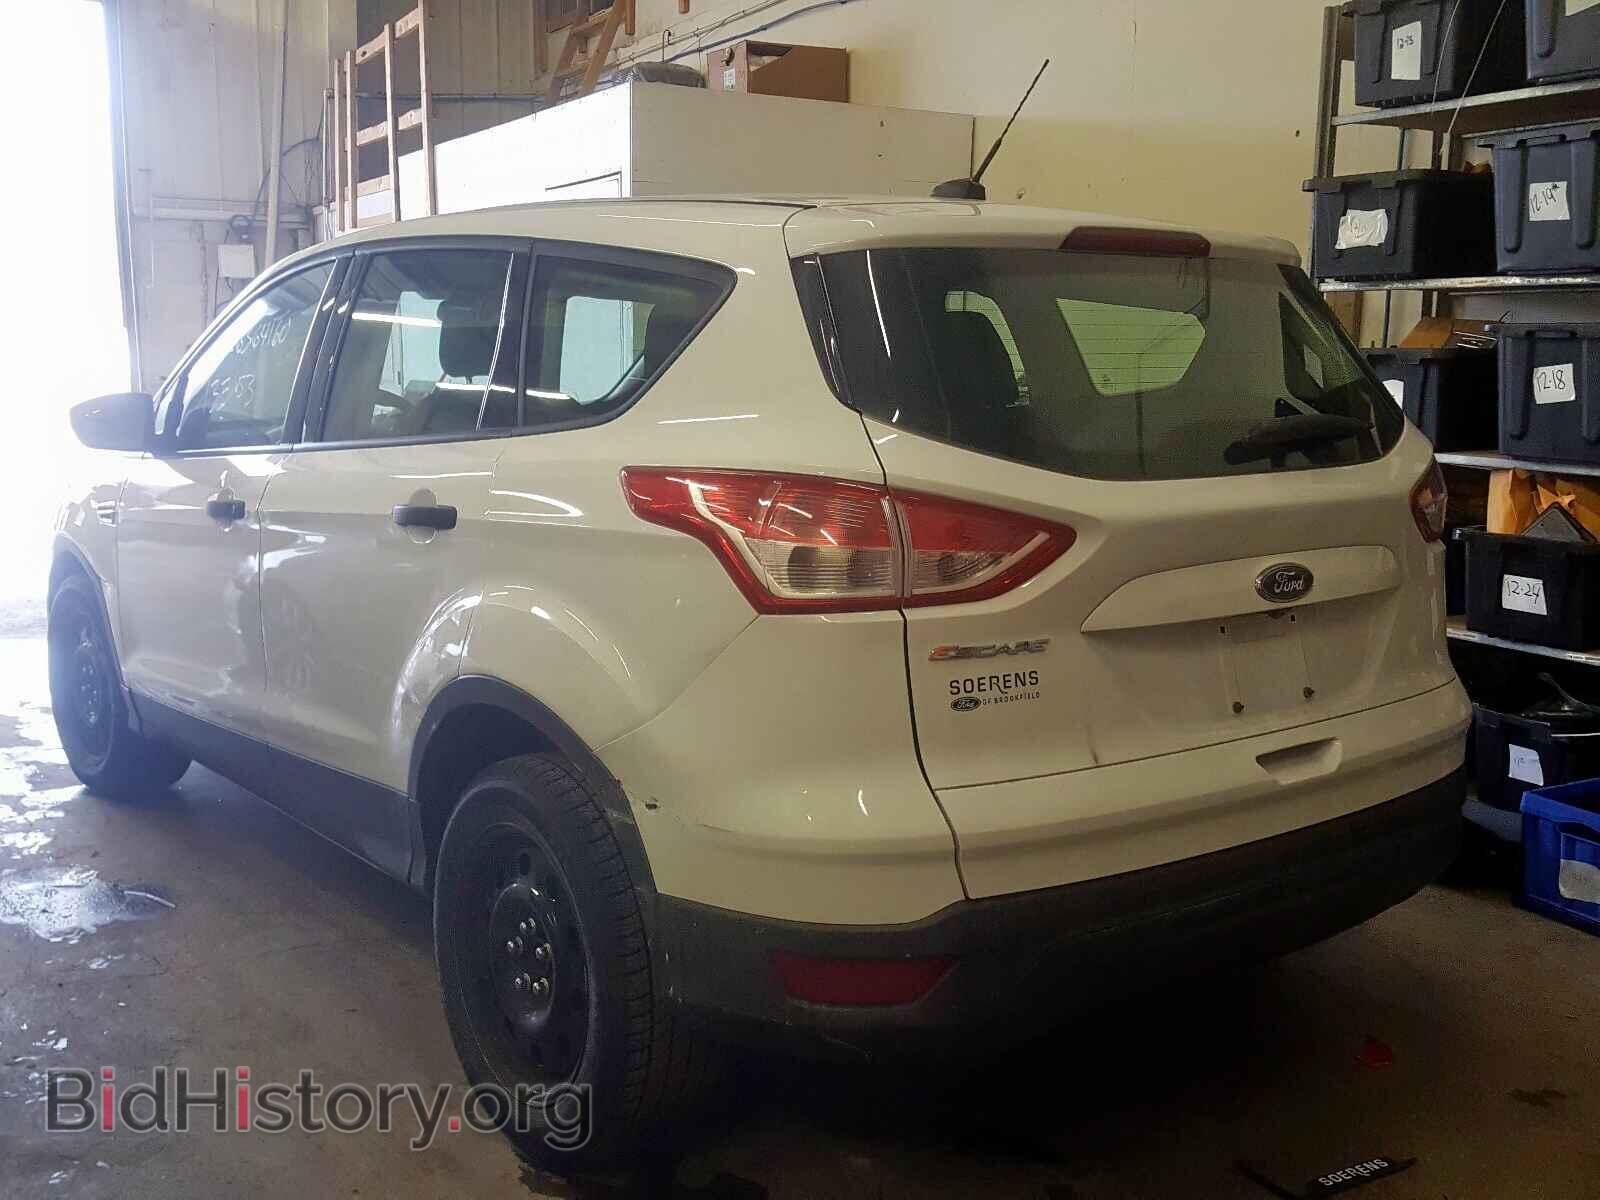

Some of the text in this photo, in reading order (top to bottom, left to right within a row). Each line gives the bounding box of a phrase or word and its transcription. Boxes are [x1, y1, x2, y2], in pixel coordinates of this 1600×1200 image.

[1273, 571, 1304, 593] Ford
[950, 670, 1039, 695] SOERENS
[1318, 1158, 1389, 1186] SOERENS
